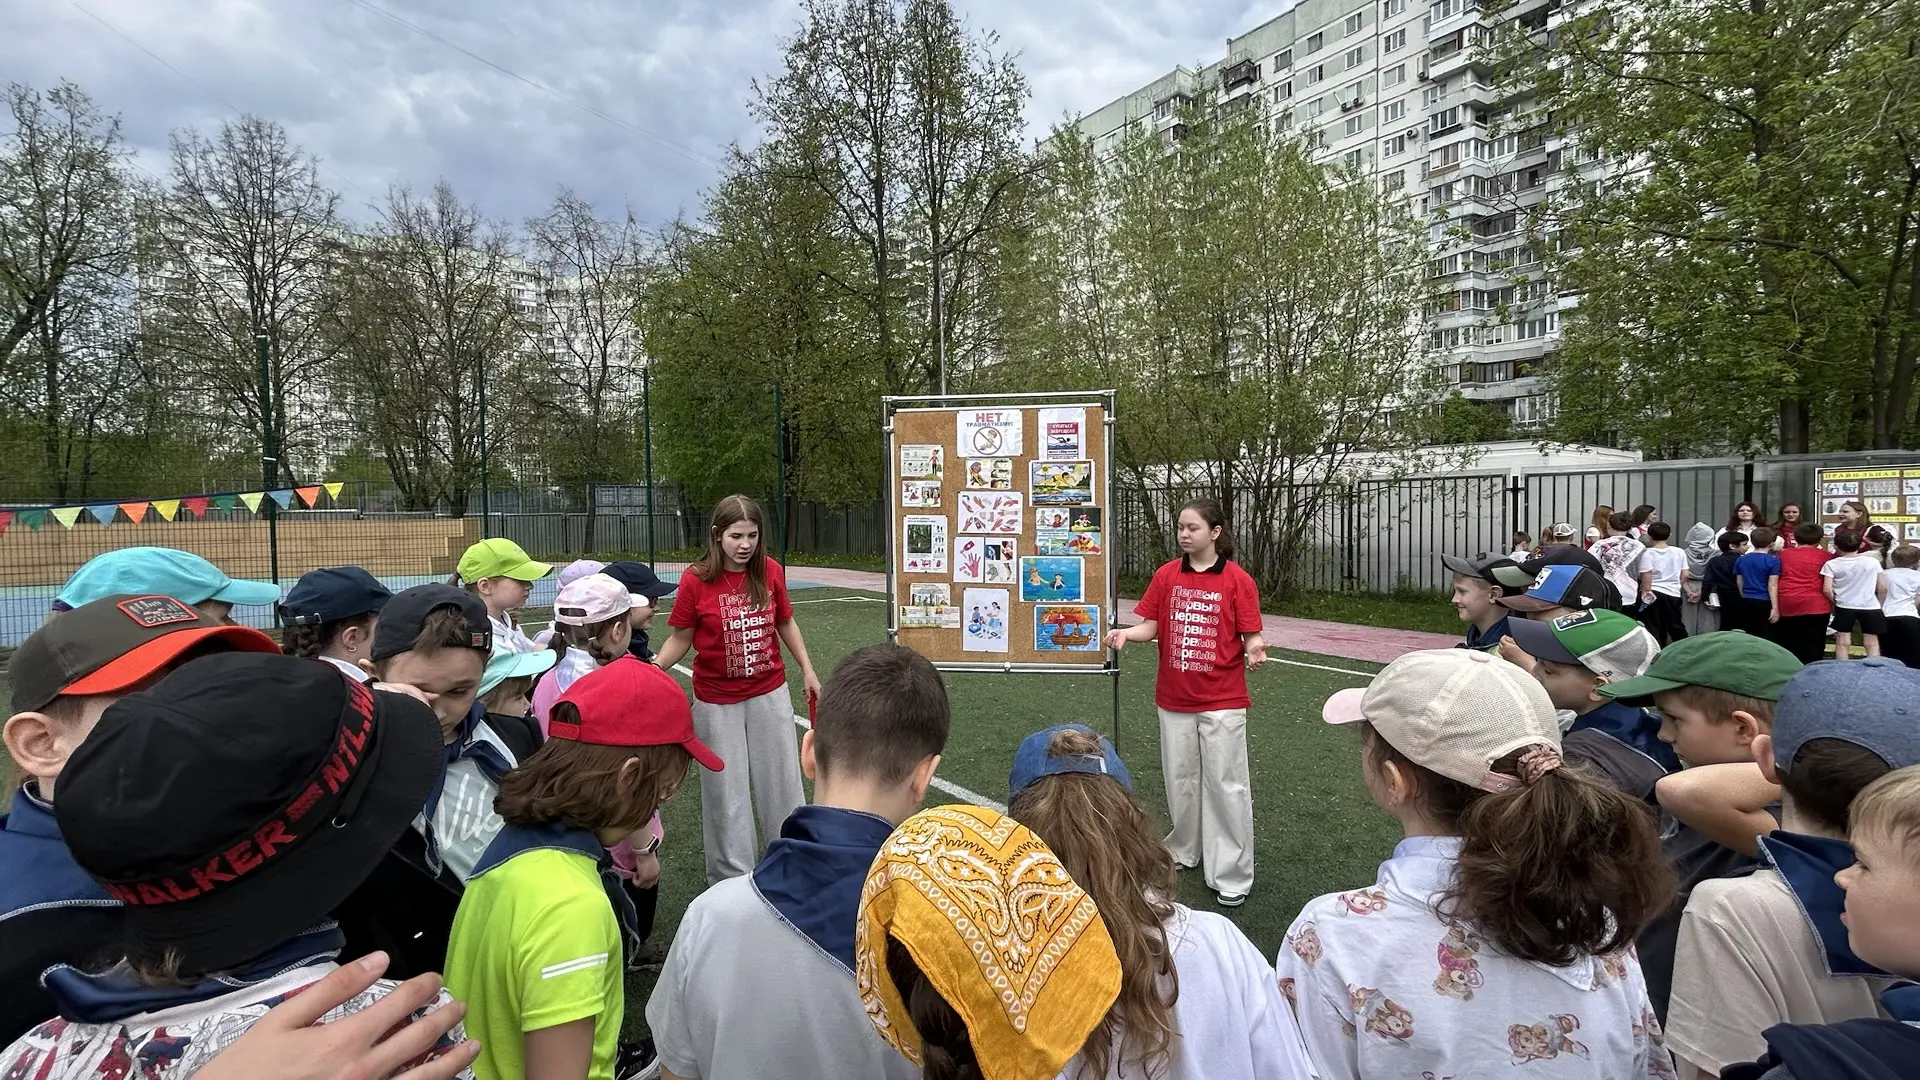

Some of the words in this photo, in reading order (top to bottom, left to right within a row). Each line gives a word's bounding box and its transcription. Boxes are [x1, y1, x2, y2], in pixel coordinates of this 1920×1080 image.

[976, 412, 1003, 422] НЕТ
[1171, 585, 1222, 601] Первые
[1170, 597, 1221, 613] Первые
[722, 613, 774, 632] Первые
[1170, 609, 1219, 625] Первые
[724, 626, 774, 644] Первые
[1170, 621, 1217, 637] Первые
[725, 637, 772, 655] Первые
[1170, 633, 1216, 649] Первые
[1169, 645, 1216, 662] Первые
